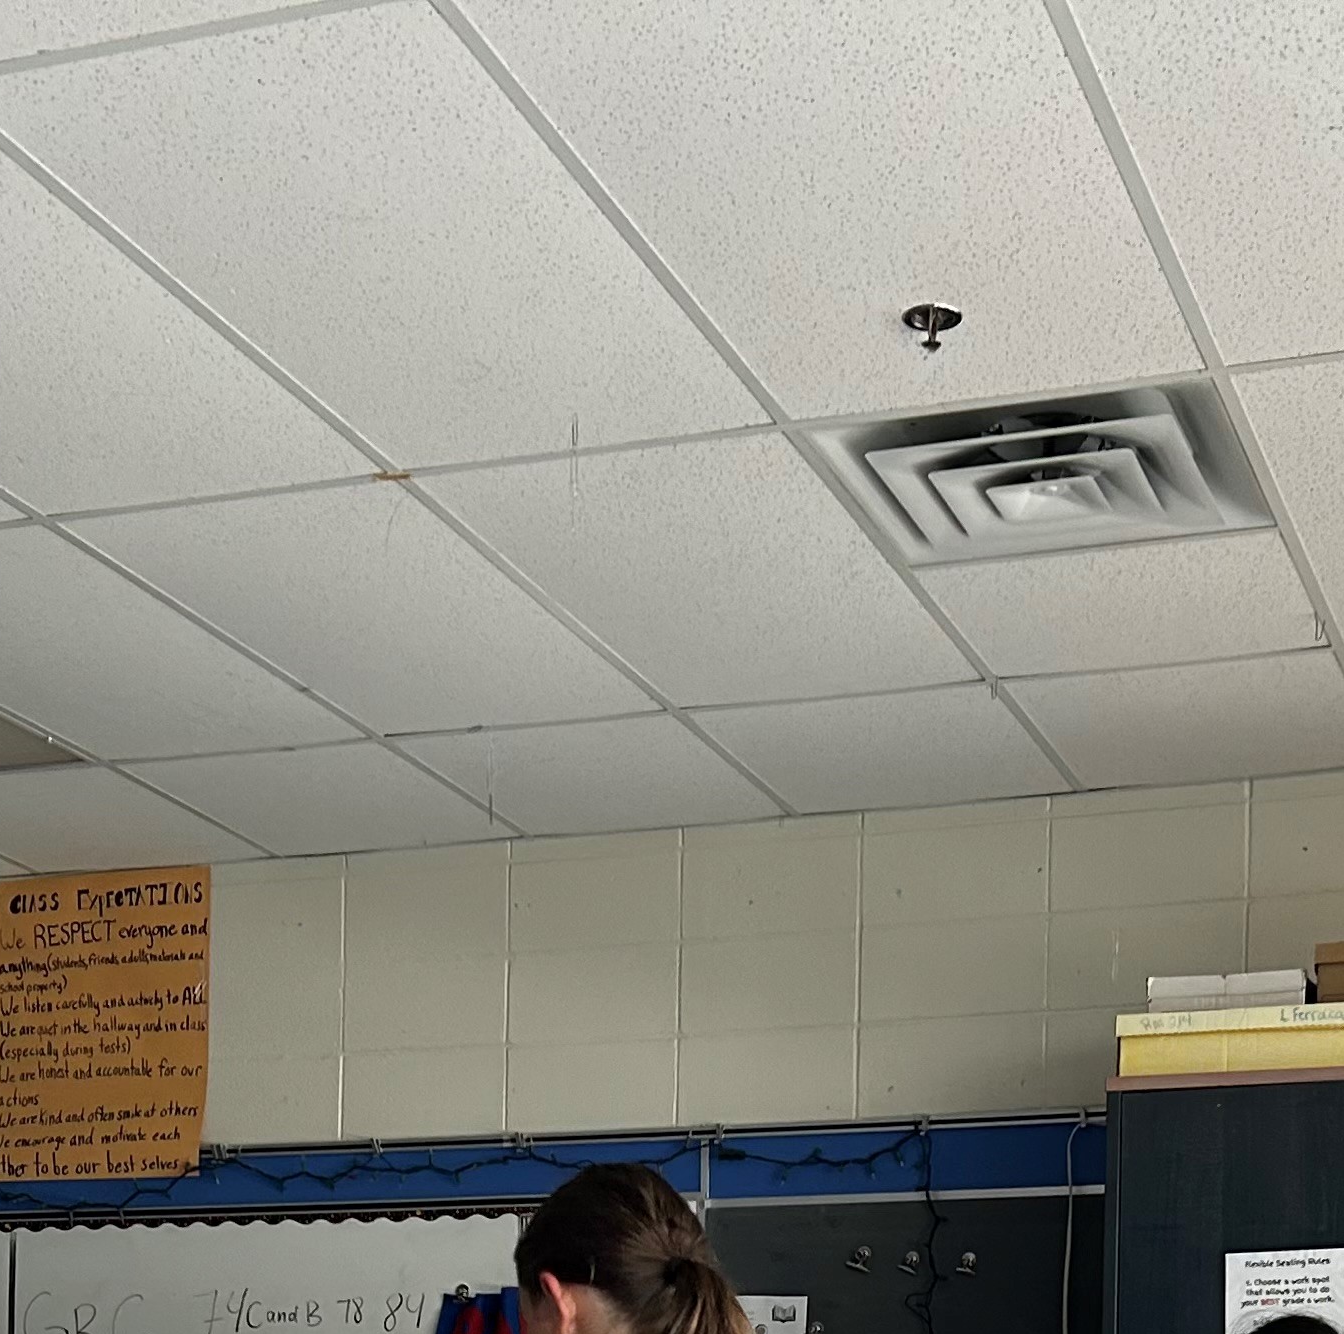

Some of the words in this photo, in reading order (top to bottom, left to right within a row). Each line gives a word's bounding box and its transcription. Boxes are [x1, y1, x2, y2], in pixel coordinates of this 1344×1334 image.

[0, 928, 25, 950] We
[34, 919, 117, 949] RESPECT
[118, 924, 177, 948] everyone
[181, 918, 208, 936] and
[0, 997, 19, 1016] We
[24, 995, 53, 1013] listen
[56, 994, 101, 1017] carefully
[102, 995, 126, 1008] and
[167, 989, 178, 1004] to
[0, 1018, 17, 1038] We
[93, 1016, 140, 1039] hallway
[143, 1017, 162, 1032] and
[165, 1020, 177, 1032] in
[180, 1014, 206, 1031] class
[0, 1039, 59, 1063] (especially
[63, 1041, 93, 1058] during
[99, 1036, 132, 1055] tests)
[19, 1071, 35, 1080] are
[38, 1060, 69, 1080] honest
[73, 1062, 93, 1080] and
[95, 1058, 153, 1077] accountable
[159, 1057, 176, 1077] for
[181, 1064, 203, 1078] our
[65, 1107, 84, 1123] and
[88, 1105, 113, 1123] often
[144, 1102, 156, 1117] at
[160, 1100, 198, 1117] others
[15, 1135, 65, 1150] encourage
[70, 1127, 93, 1146] and
[101, 1124, 146, 1142] motivate
[152, 1126, 180, 1141] each
[35, 1151, 48, 1177] to
[53, 1151, 68, 1176] be
[75, 1161, 99, 1175] our
[107, 1150, 134, 1173] best
[141, 1155, 178, 1171] selves
[1245, 1259, 1274, 1268] Flexible
[1276, 1259, 1306, 1268] Seating
[1307, 1257, 1332, 1265] Rules
[1245, 1288, 1263, 1296] that
[1292, 1287, 1307, 1296] you
[1254, 1278, 1282, 1286] Choose
[1291, 1276, 1309, 1284] work
[1312, 1276, 1330, 1284] spot
[266, 1305, 299, 1324] and
[306, 1300, 322, 1328] B
[337, 1296, 363, 1324] 78
[384, 1292, 425, 1332] 84
[1240, 1299, 1258, 1309] your
[1282, 1297, 1306, 1307] grade
